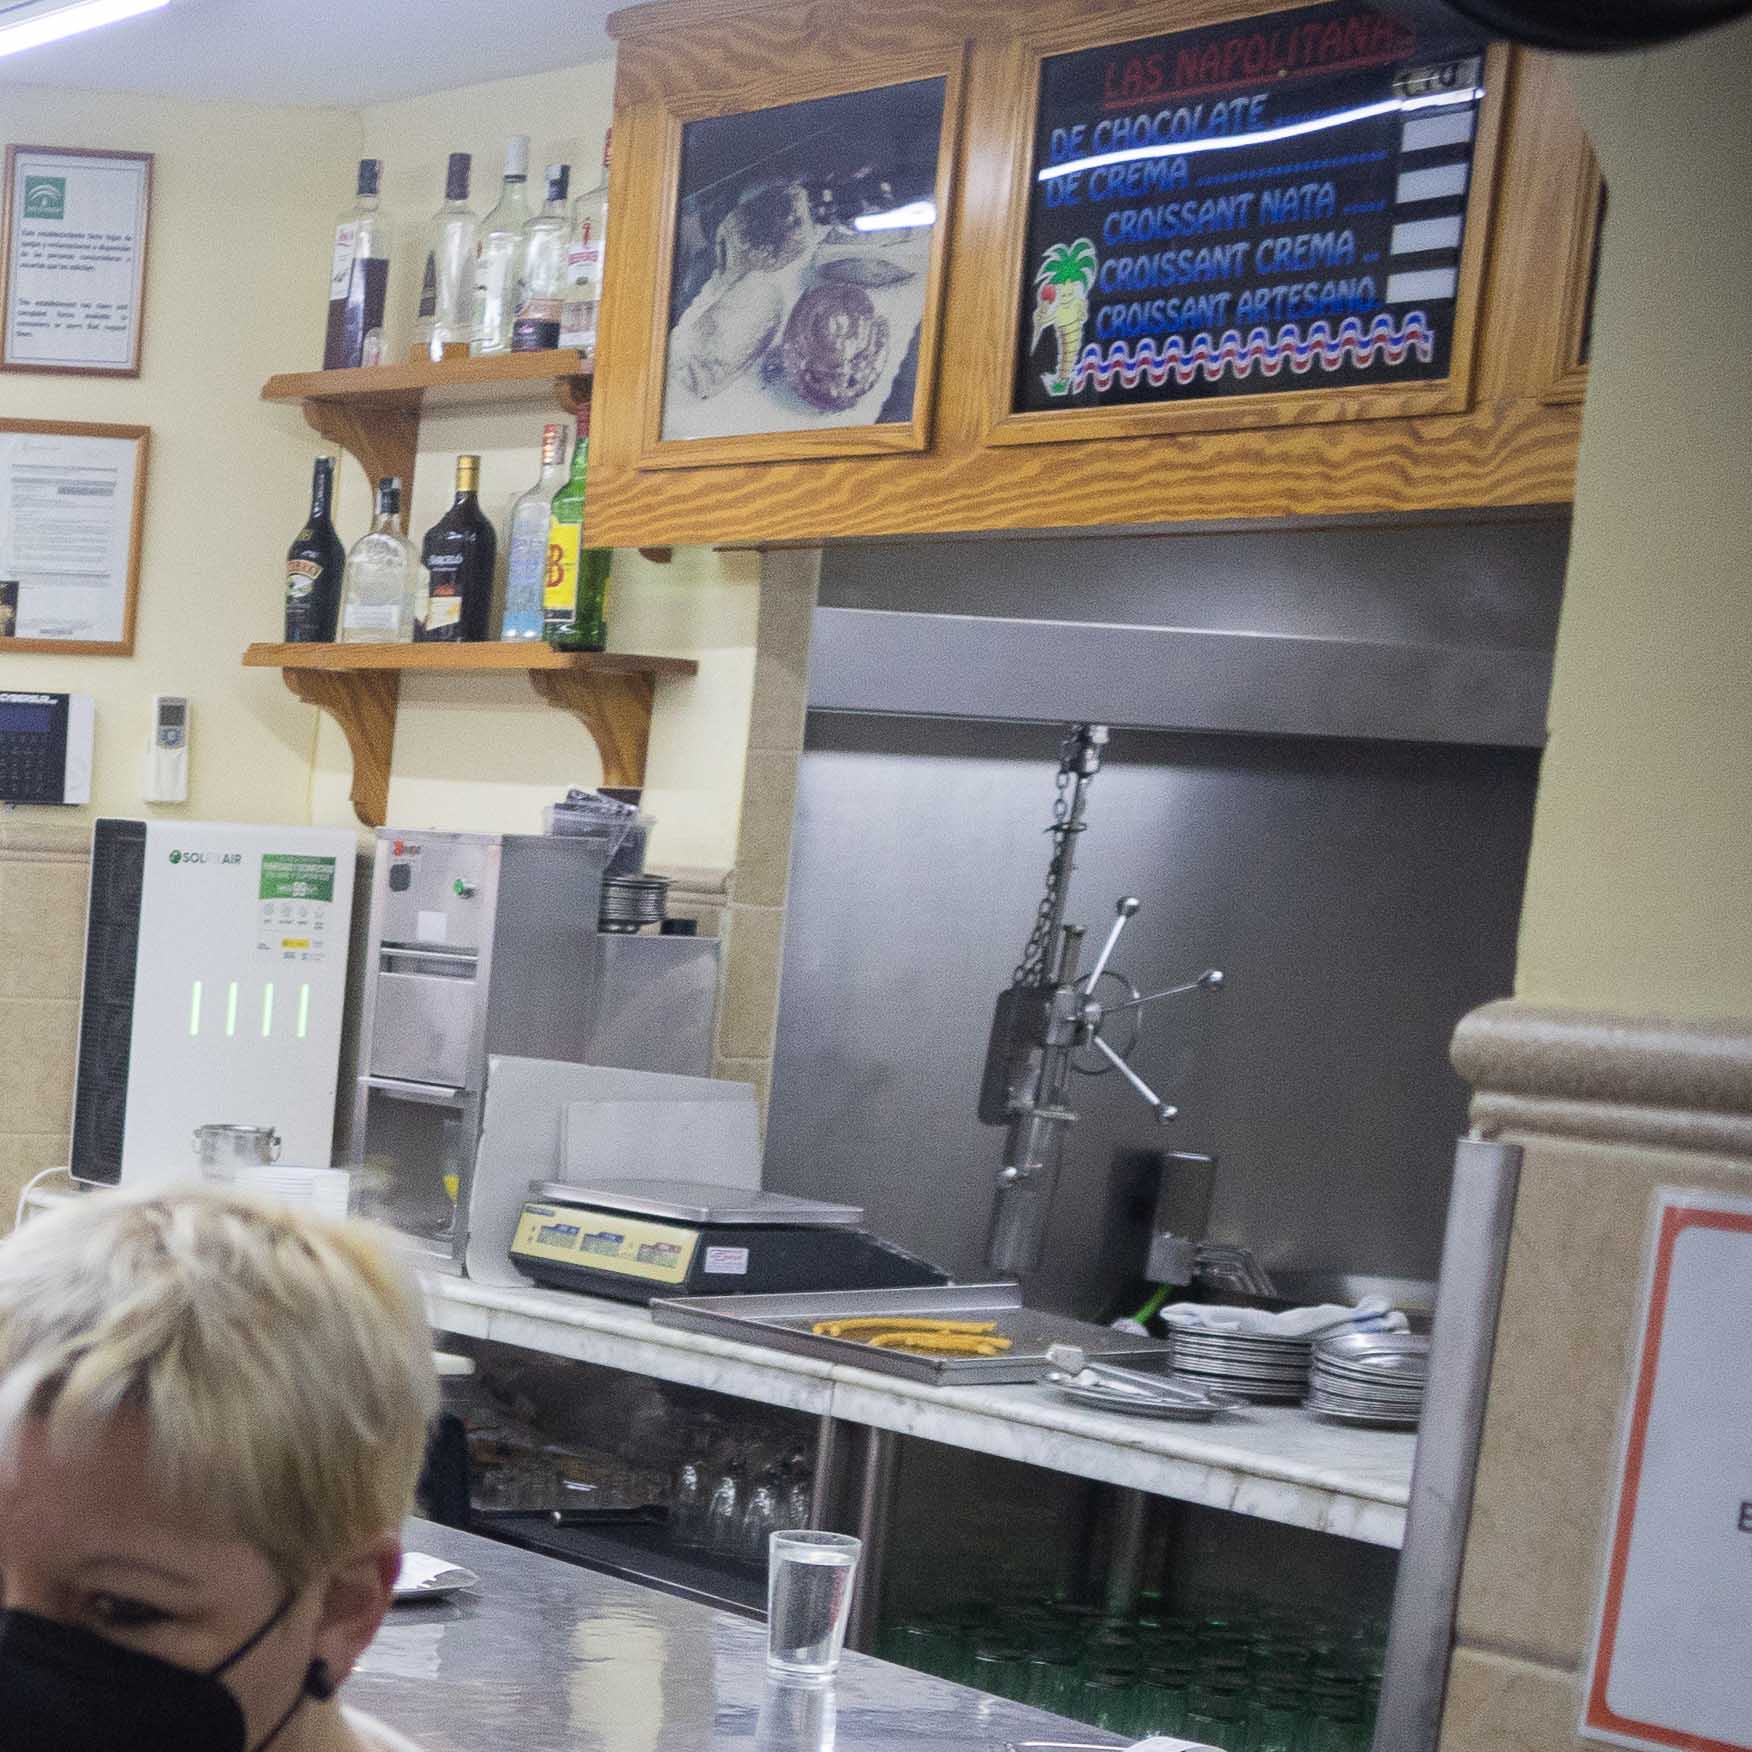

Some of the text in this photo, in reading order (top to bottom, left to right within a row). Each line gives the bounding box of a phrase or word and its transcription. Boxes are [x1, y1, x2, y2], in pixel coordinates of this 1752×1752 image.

[1104, 53, 1164, 97] LAS
[1051, 93, 1270, 164] DE CHOCOLATE
[1044, 157, 1189, 208] DE CREMA
[1103, 182, 1338, 245] CROISSANT NATA
[1098, 229, 1355, 294] CROISSANT CREMA
[1096, 276, 1376, 340] CROISSANT ARTESANO
